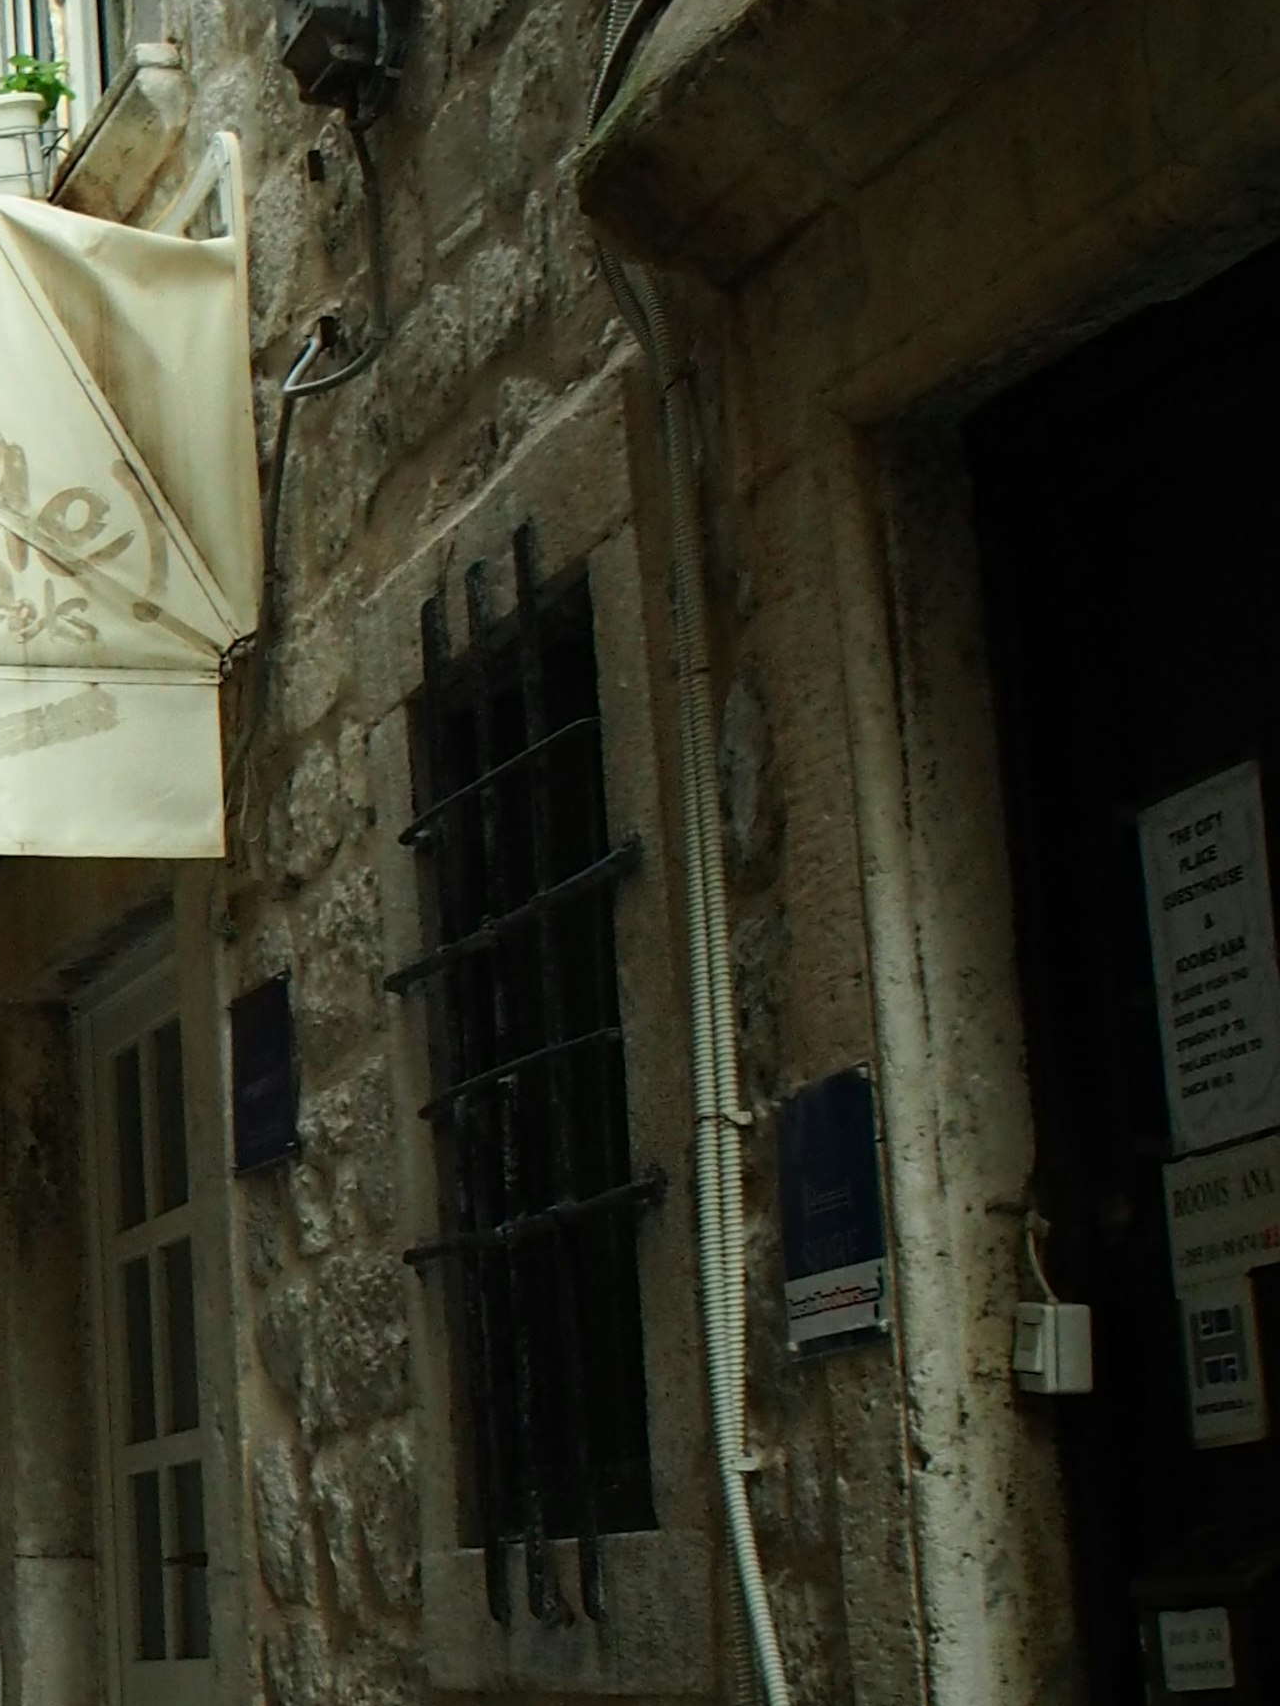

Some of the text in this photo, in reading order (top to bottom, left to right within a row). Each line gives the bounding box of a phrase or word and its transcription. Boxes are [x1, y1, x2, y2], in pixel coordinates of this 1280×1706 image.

[1178, 844, 1219, 874] PLACE
[1163, 865, 1244, 911] GUESTHOUSE
[1203, 912, 1215, 930] &
